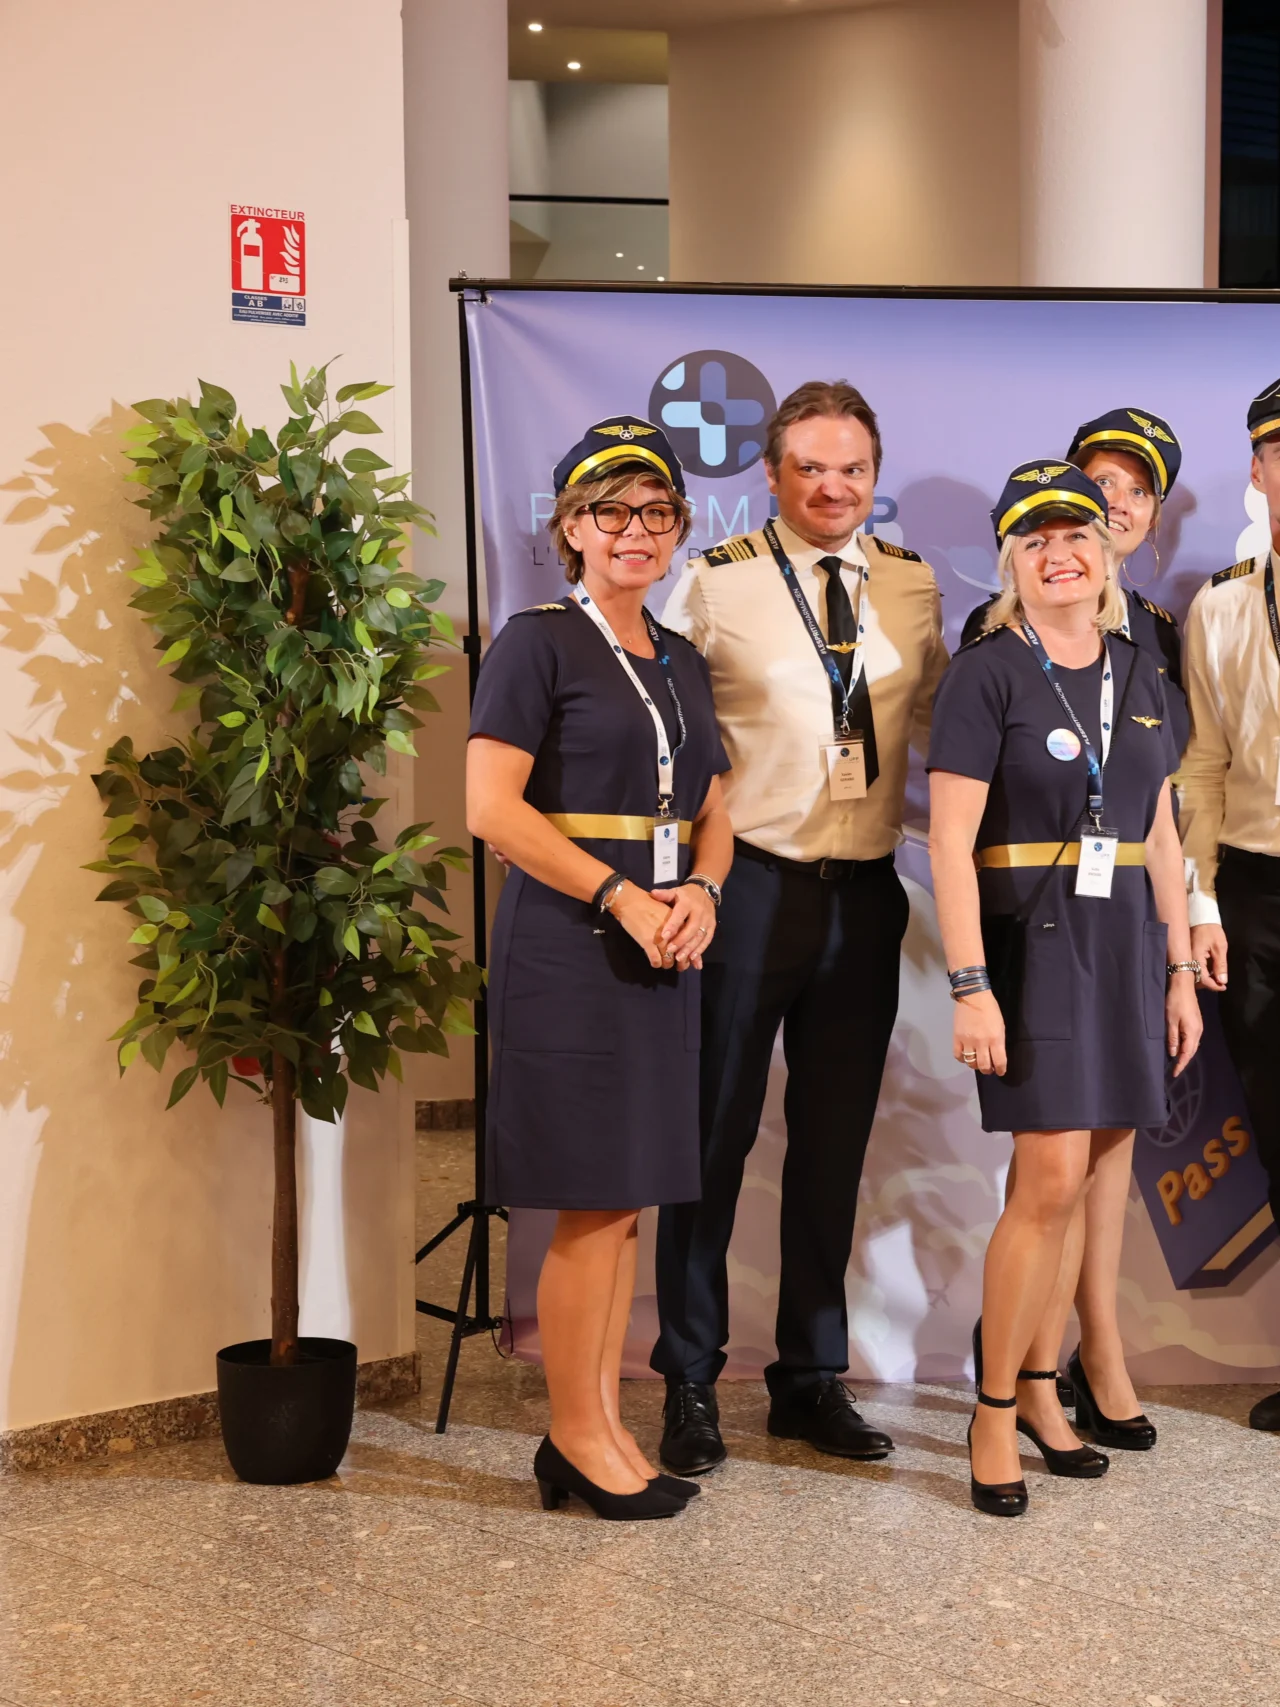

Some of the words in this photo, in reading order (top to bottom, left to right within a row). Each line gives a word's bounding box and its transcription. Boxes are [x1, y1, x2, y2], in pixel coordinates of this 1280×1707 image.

[230, 204, 305, 220] EXTINCTEUR
[248, 299, 255, 307] A
[1156, 1115, 1250, 1227] Pass
